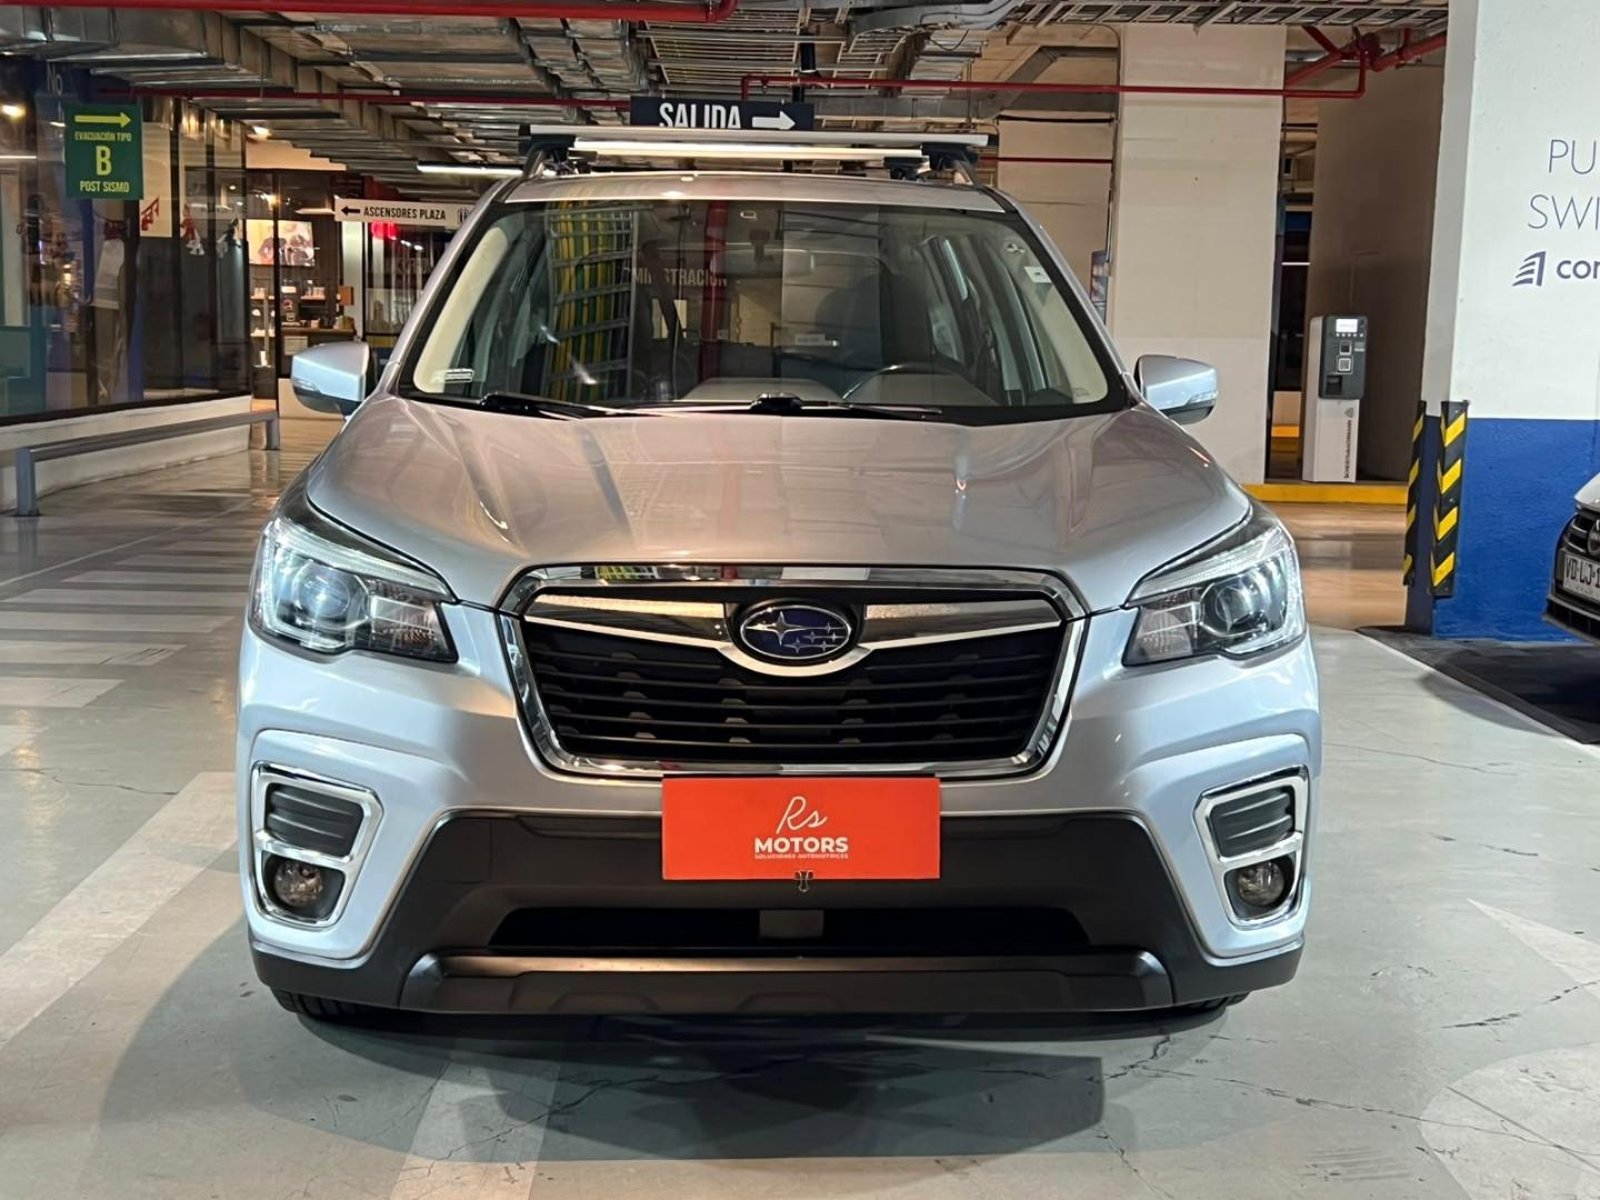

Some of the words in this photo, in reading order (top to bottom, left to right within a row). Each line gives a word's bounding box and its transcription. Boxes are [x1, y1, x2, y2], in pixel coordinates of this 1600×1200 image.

[659, 103, 742, 129] SALIDA
[116, 132, 131, 141] TIPO
[96, 145, 112, 176] B
[80, 181, 101, 192] POST
[103, 181, 130, 192] SISMO
[363, 207, 417, 219] ASCENSORES
[420, 209, 446, 220] PLAZA
[754, 836, 849, 853] MOTORS
